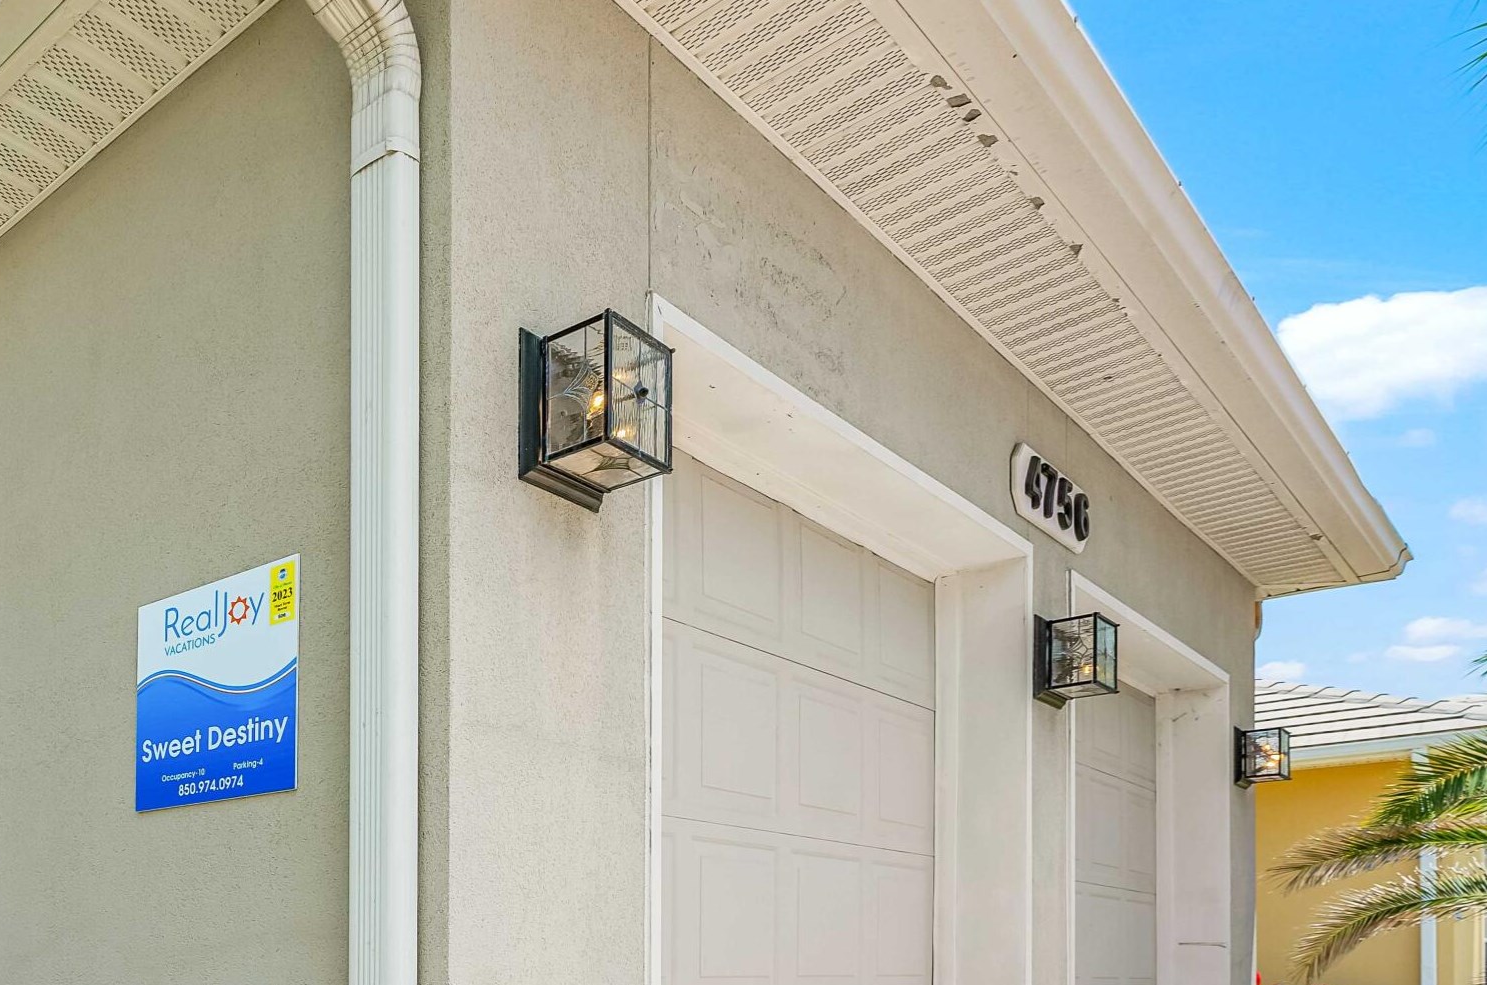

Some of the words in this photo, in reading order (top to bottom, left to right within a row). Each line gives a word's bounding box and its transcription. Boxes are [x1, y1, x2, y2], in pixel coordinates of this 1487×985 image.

[1024, 455, 1090, 542] 4756
[272, 587, 293, 603] 2023
[164, 590, 265, 642] RealJoy
[164, 633, 216, 657] VACATIONS
[141, 729, 202, 764] Sweet
[207, 715, 289, 751] Destiny
[233, 757, 264, 771] Parking-4
[178, 774, 244, 797] 850.974.0974
